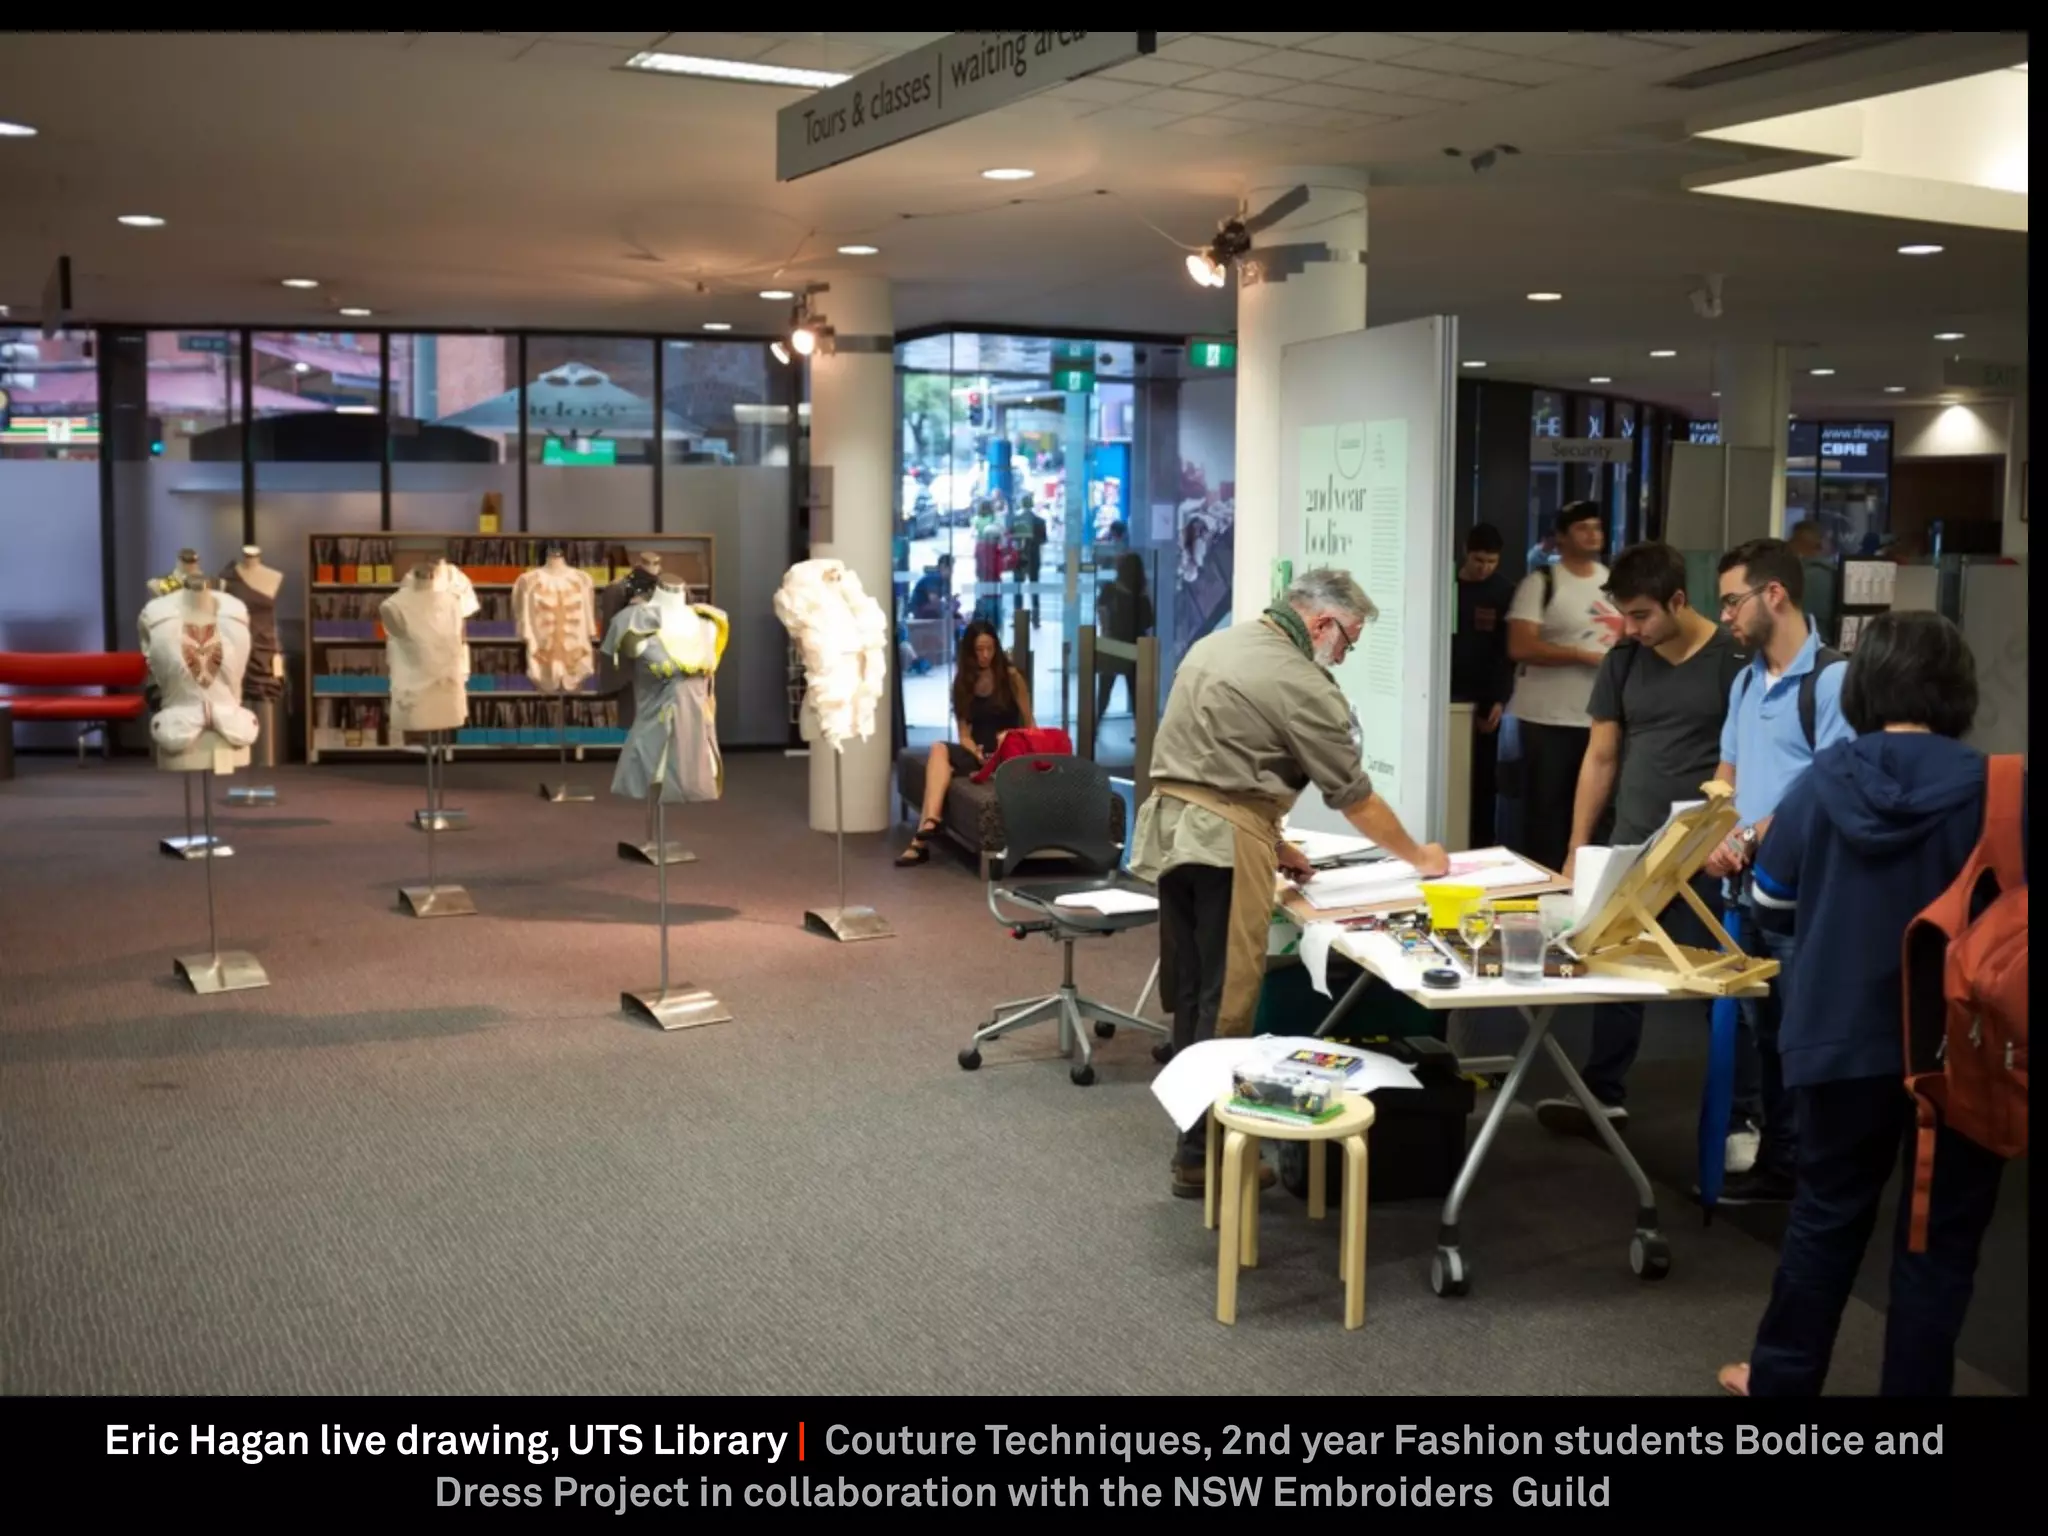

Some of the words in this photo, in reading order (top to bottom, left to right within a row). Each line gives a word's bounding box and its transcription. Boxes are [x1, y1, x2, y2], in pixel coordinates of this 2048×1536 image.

[802, 108, 847, 145] Tours
[851, 90, 866, 127] &
[870, 73, 931, 120] classes
[950, 33, 1028, 87] waiting
[1551, 441, 1613, 461] Security
[1821, 442, 1869, 457] CBRE
